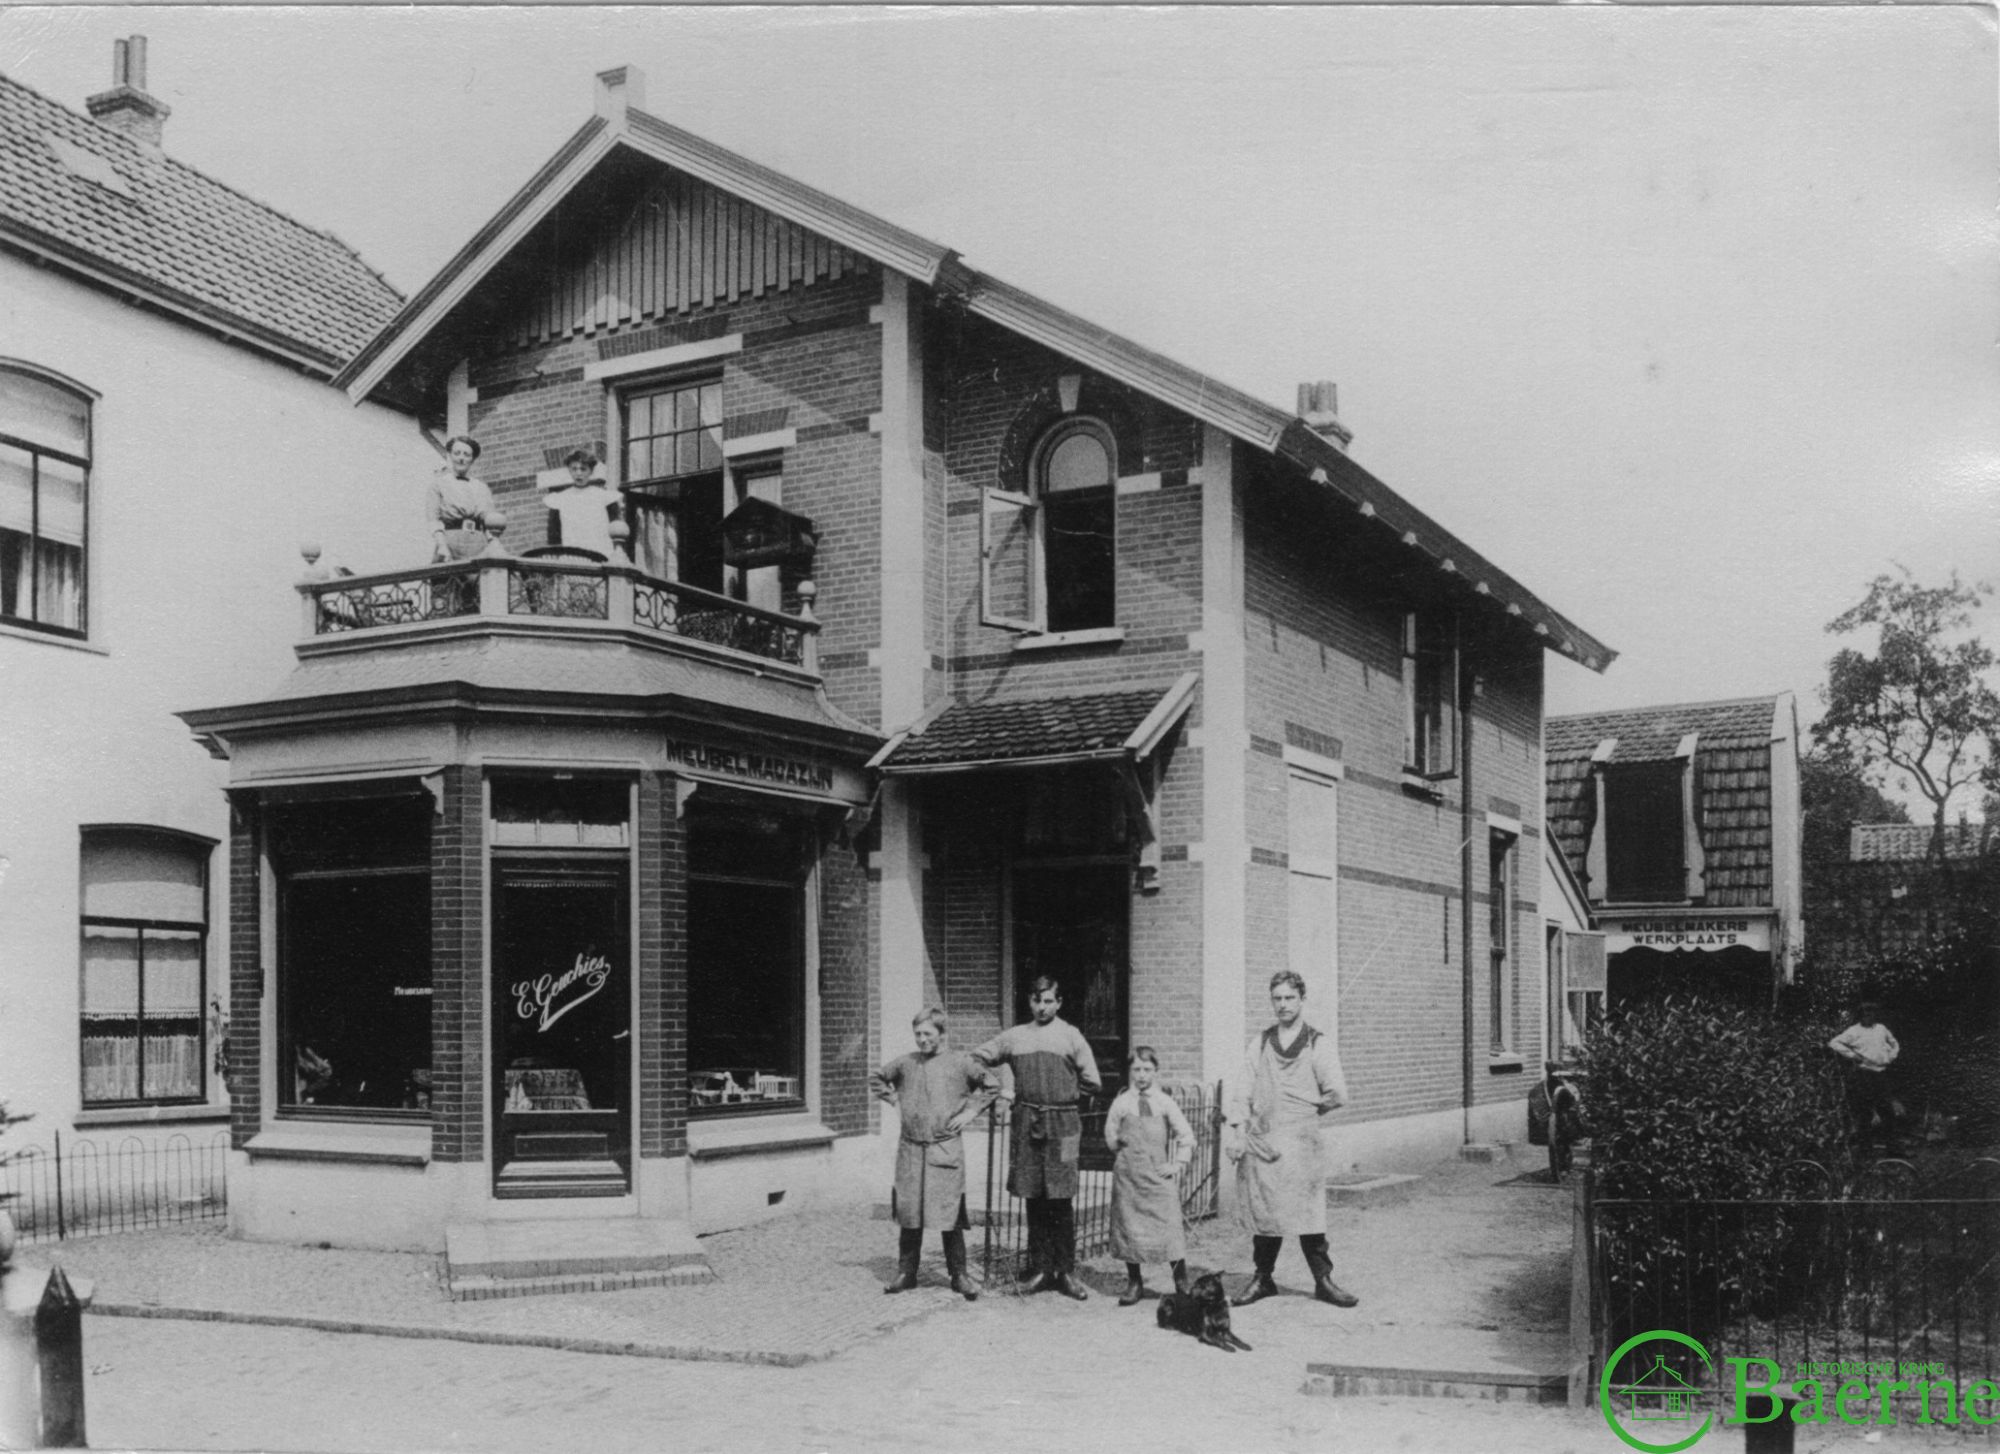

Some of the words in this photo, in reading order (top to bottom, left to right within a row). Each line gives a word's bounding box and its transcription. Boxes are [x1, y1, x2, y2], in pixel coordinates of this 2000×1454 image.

[1621, 920, 1748, 932] MEUBELMAKERS
[1632, 934, 1737, 944] WERKPLAATS
[512, 981, 537, 1018] E.
